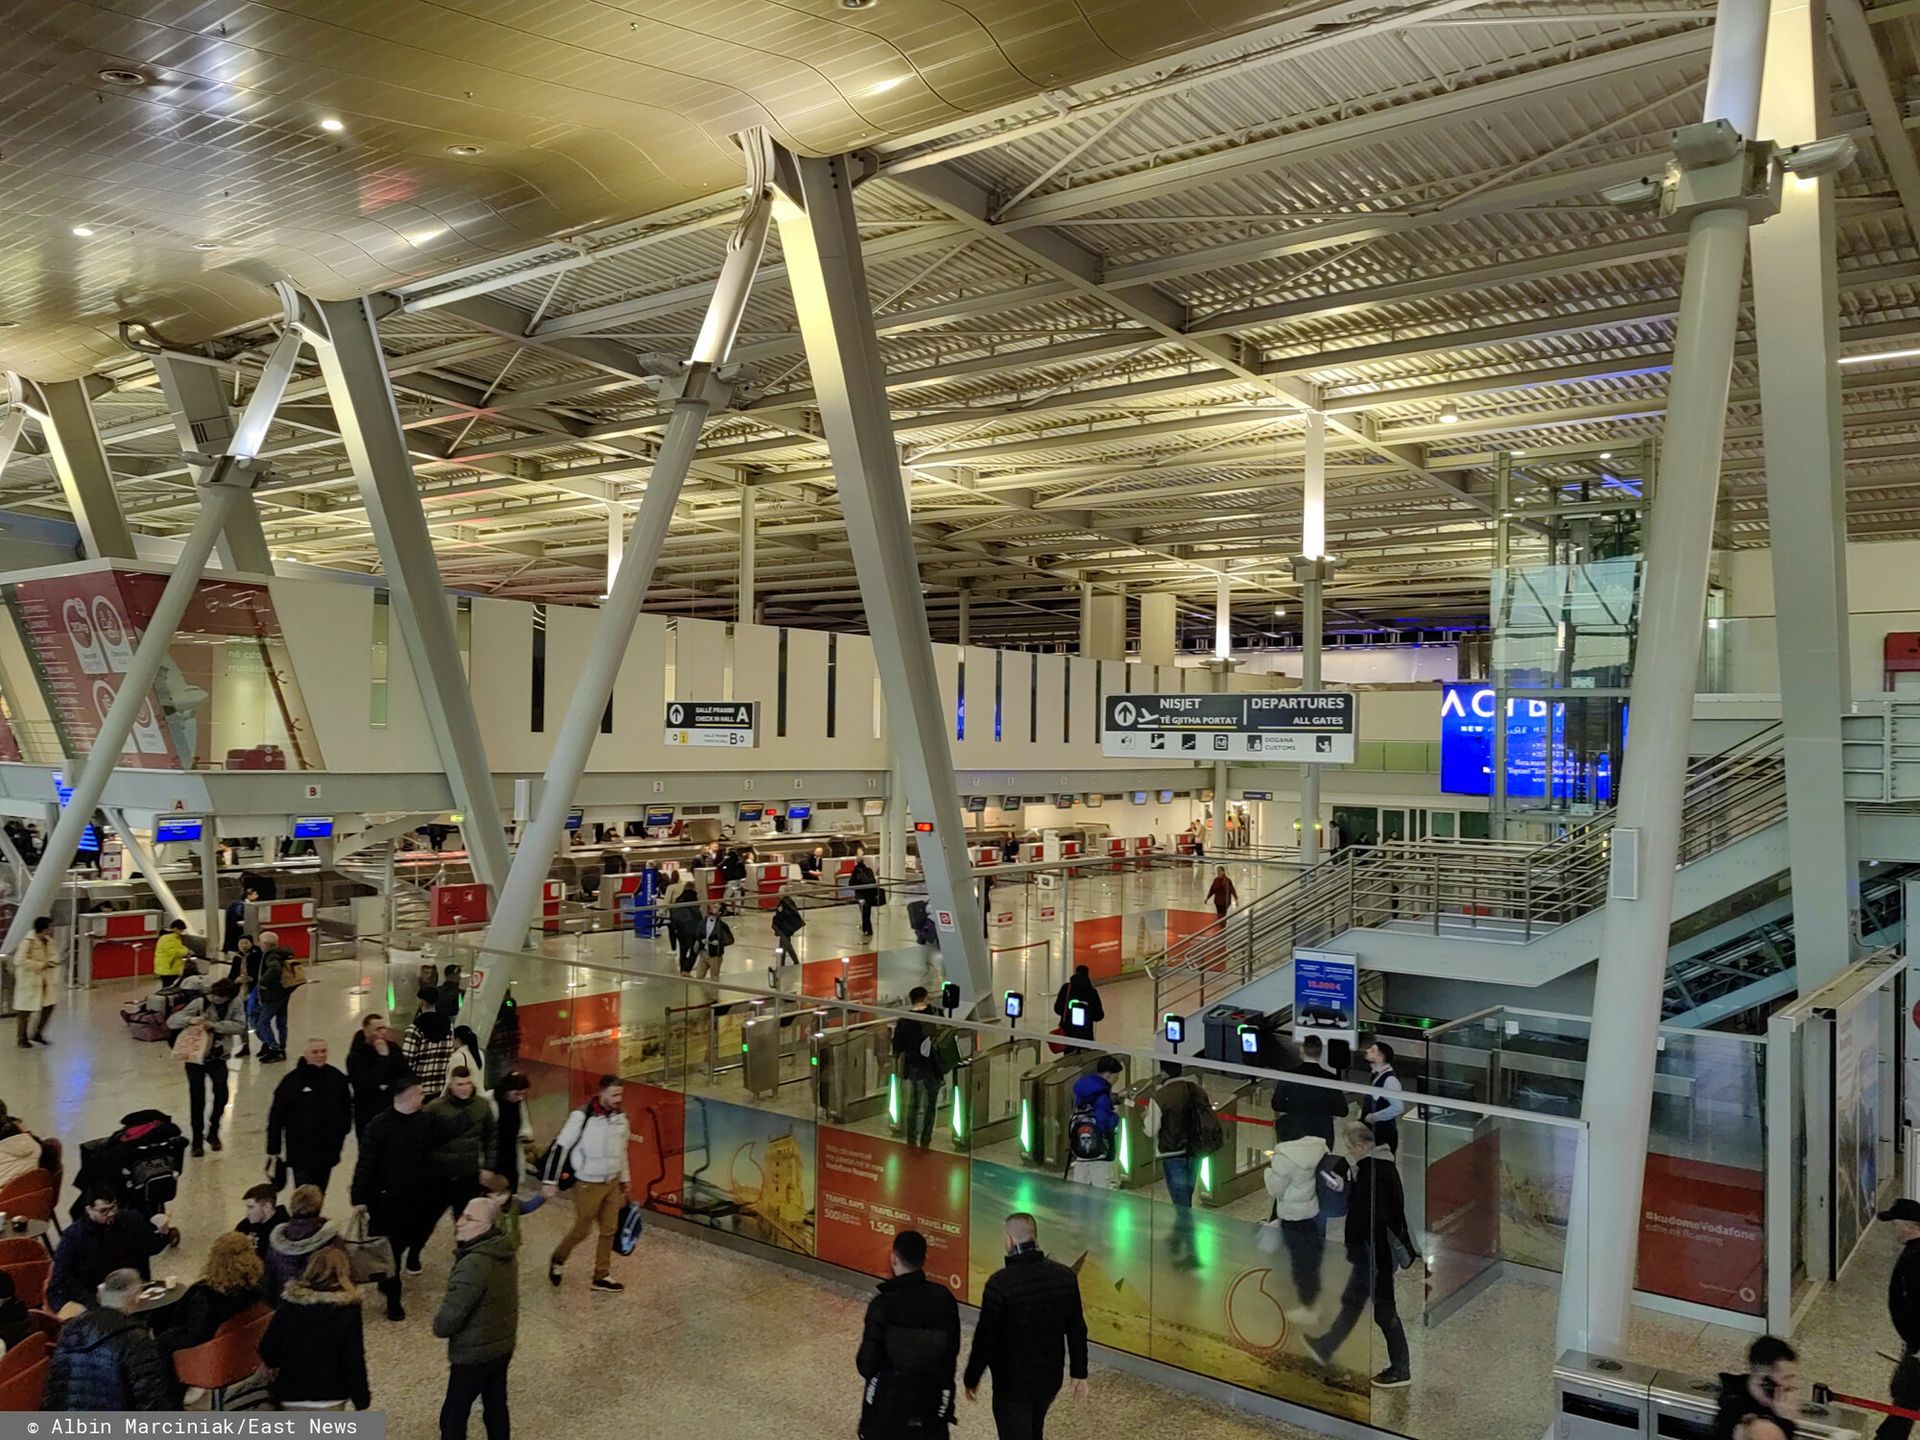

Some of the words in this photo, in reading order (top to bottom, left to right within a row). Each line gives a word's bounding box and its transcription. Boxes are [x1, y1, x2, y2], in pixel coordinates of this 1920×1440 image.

[1160, 698, 1202, 712] NISJET
[1251, 697, 1346, 709] DEPARTURES
[736, 706, 749, 722] A
[1160, 714, 1171, 724] TË
[1172, 716, 1202, 726] GJITHA
[1202, 716, 1238, 724] PORTAT
[1292, 716, 1310, 724] ALL
[1312, 716, 1344, 724] GATES
[730, 733, 738, 744] B
[309, 786, 317, 796] B
[175, 800, 184, 810] A
[825, 1194, 848, 1205] TRAVEL
[870, 1205, 894, 1218] TRAVEL
[869, 1220, 896, 1236] 1.5GB
[917, 1217, 942, 1230] TRAVEL
[942, 1223, 961, 1234] PACK
